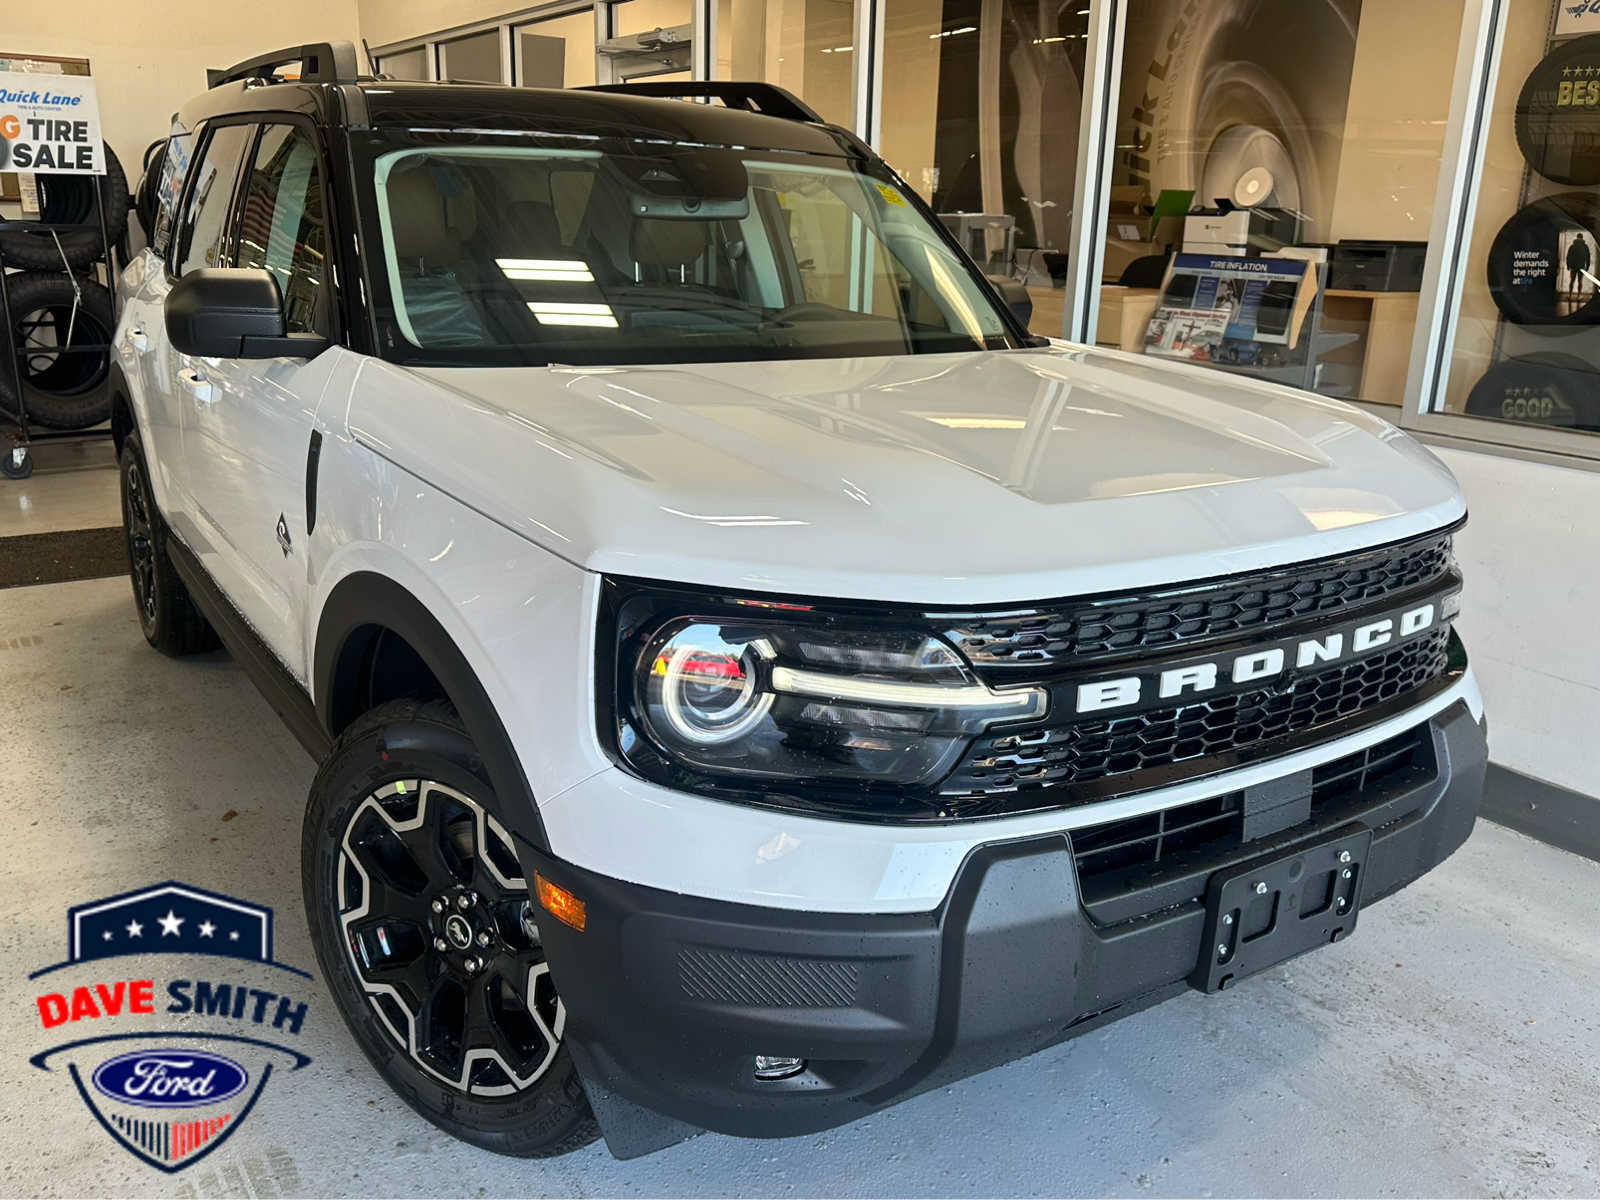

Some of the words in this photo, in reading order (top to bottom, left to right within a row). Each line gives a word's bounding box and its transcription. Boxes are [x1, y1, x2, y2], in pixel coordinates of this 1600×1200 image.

[43, 91, 81, 106] Lane
[27, 118, 88, 142] TIRE
[12, 142, 93, 169] SALE
[1513, 251, 1540, 259] Winter
[1209, 260, 1226, 269] TIRE
[1227, 262, 1268, 272] INFLATION
[1513, 260, 1549, 268] demands
[1528, 268, 1546, 278] right
[1502, 398, 1553, 418] GOOD
[1076, 603, 1434, 713] BRONCO
